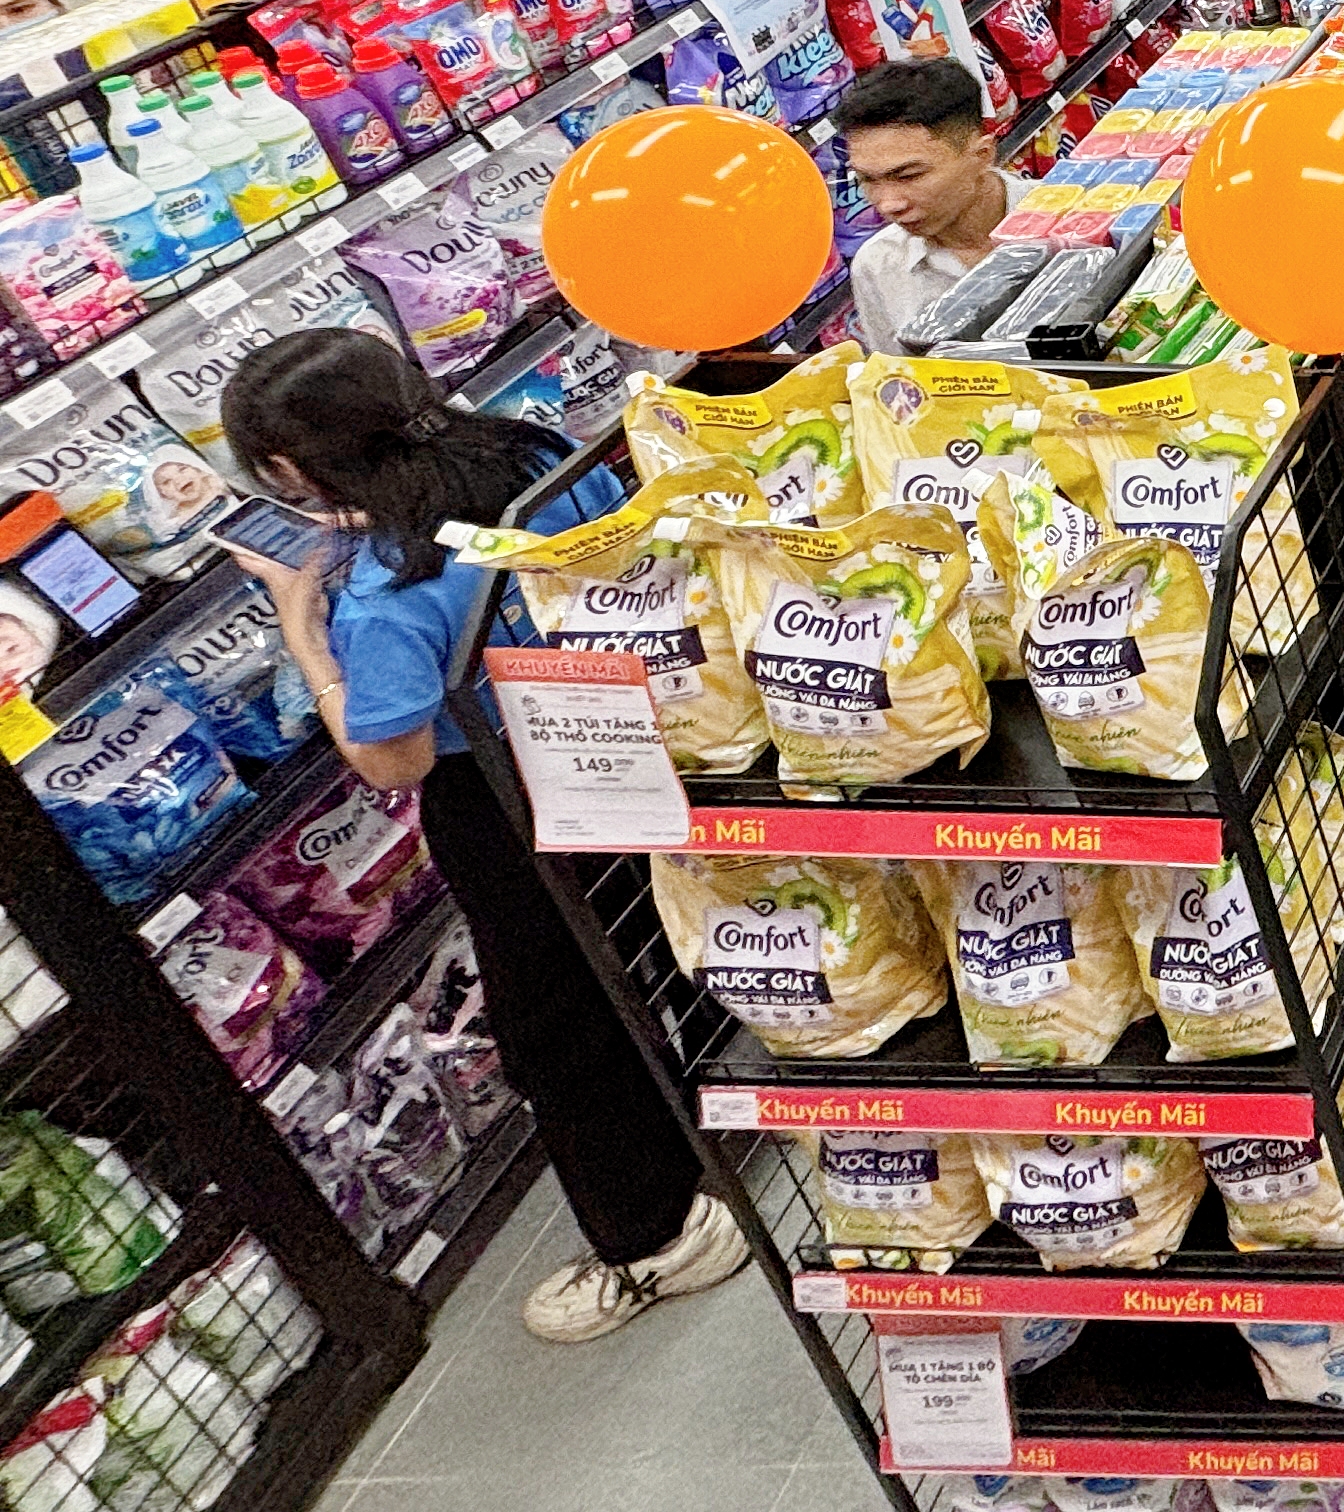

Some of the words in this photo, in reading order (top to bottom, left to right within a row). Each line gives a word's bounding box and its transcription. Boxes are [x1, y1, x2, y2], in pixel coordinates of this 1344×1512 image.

[437, 37, 484, 72] OMO
[1121, 473, 1223, 516] Comfort
[584, 577, 677, 616] Comfort
[774, 598, 884, 647] Comfort
[756, 658, 822, 688] NƯỚC
[827, 665, 877, 697] GIẶT
[592, 731, 664, 745] COOKING
[573, 756, 613, 773] 149
[935, 822, 1040, 854] Khuyến
[712, 920, 812, 957] Comfort
[707, 969, 766, 991] NƯỚC
[1019, 1156, 1113, 1192] Comfort
[922, 1394, 954, 1409] 199
